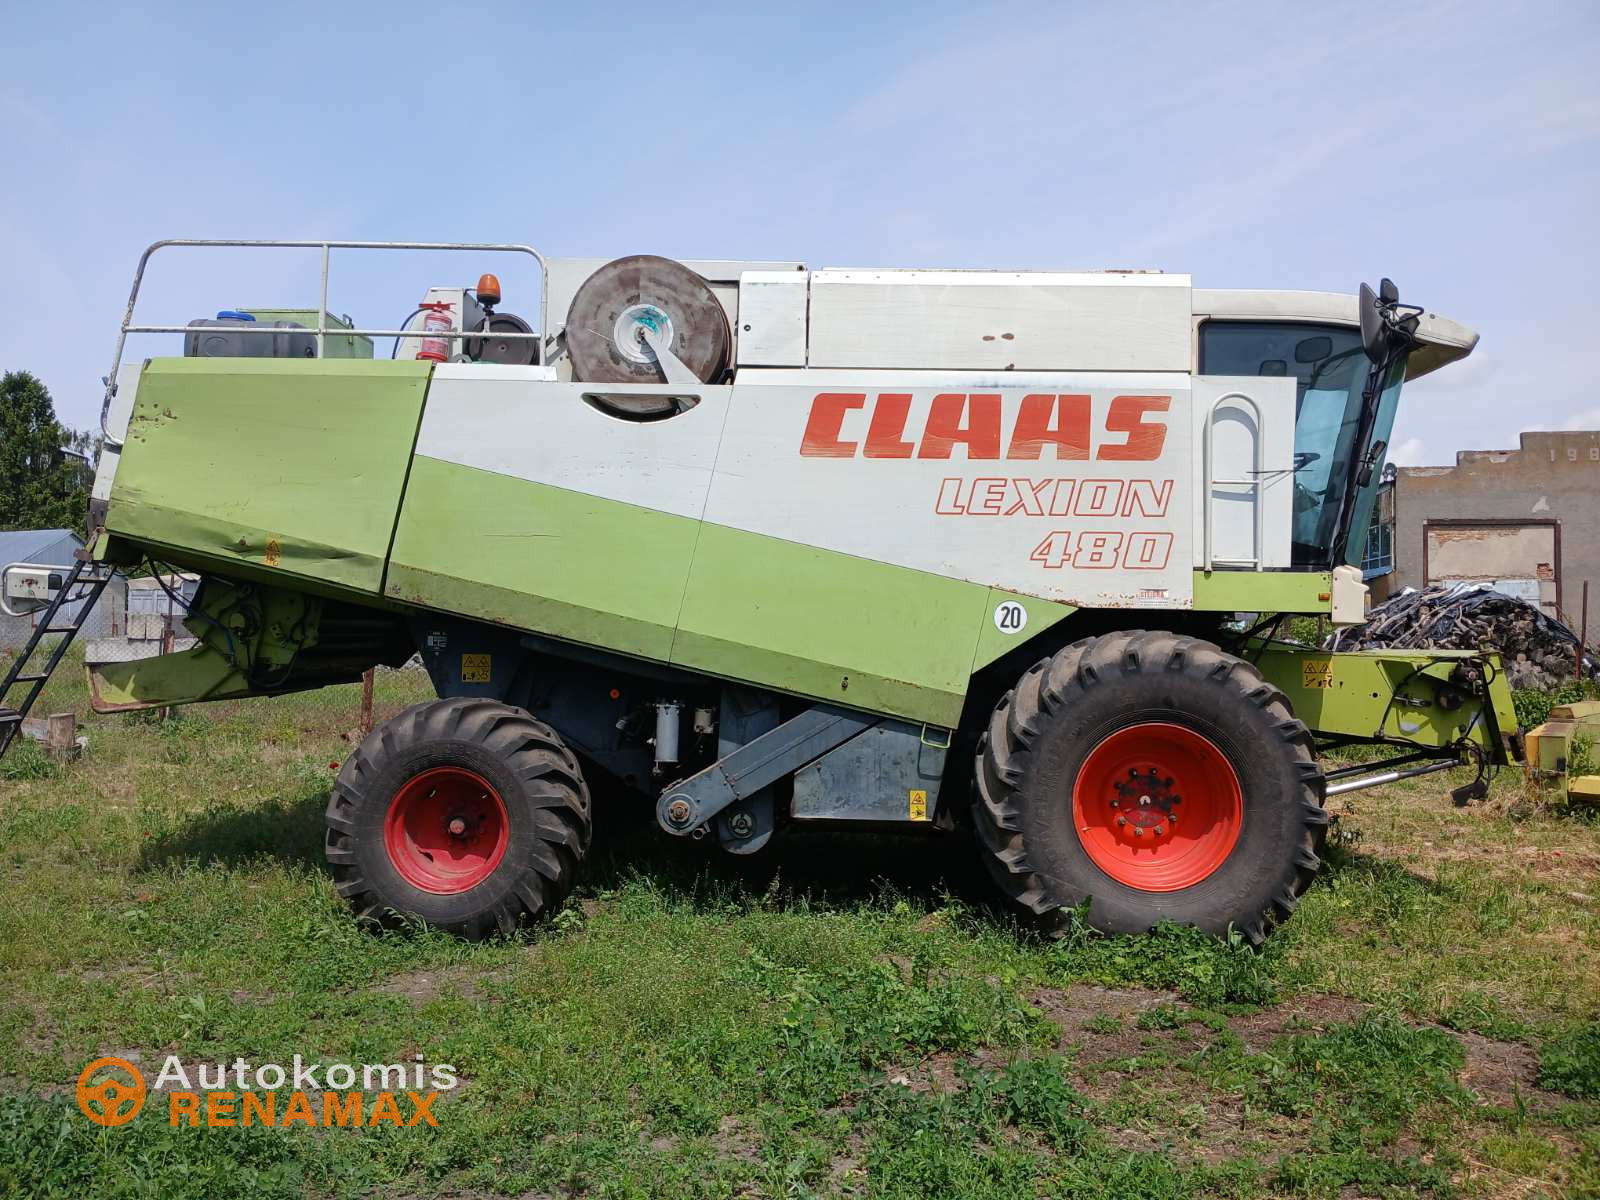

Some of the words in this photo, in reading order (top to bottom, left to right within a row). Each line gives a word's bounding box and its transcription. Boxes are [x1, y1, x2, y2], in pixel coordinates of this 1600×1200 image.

[800, 393, 1172, 461] CLAAS
[935, 478, 1174, 517] LEXION
[1030, 531, 1174, 570] 480
[1000, 606, 1021, 629] 20
